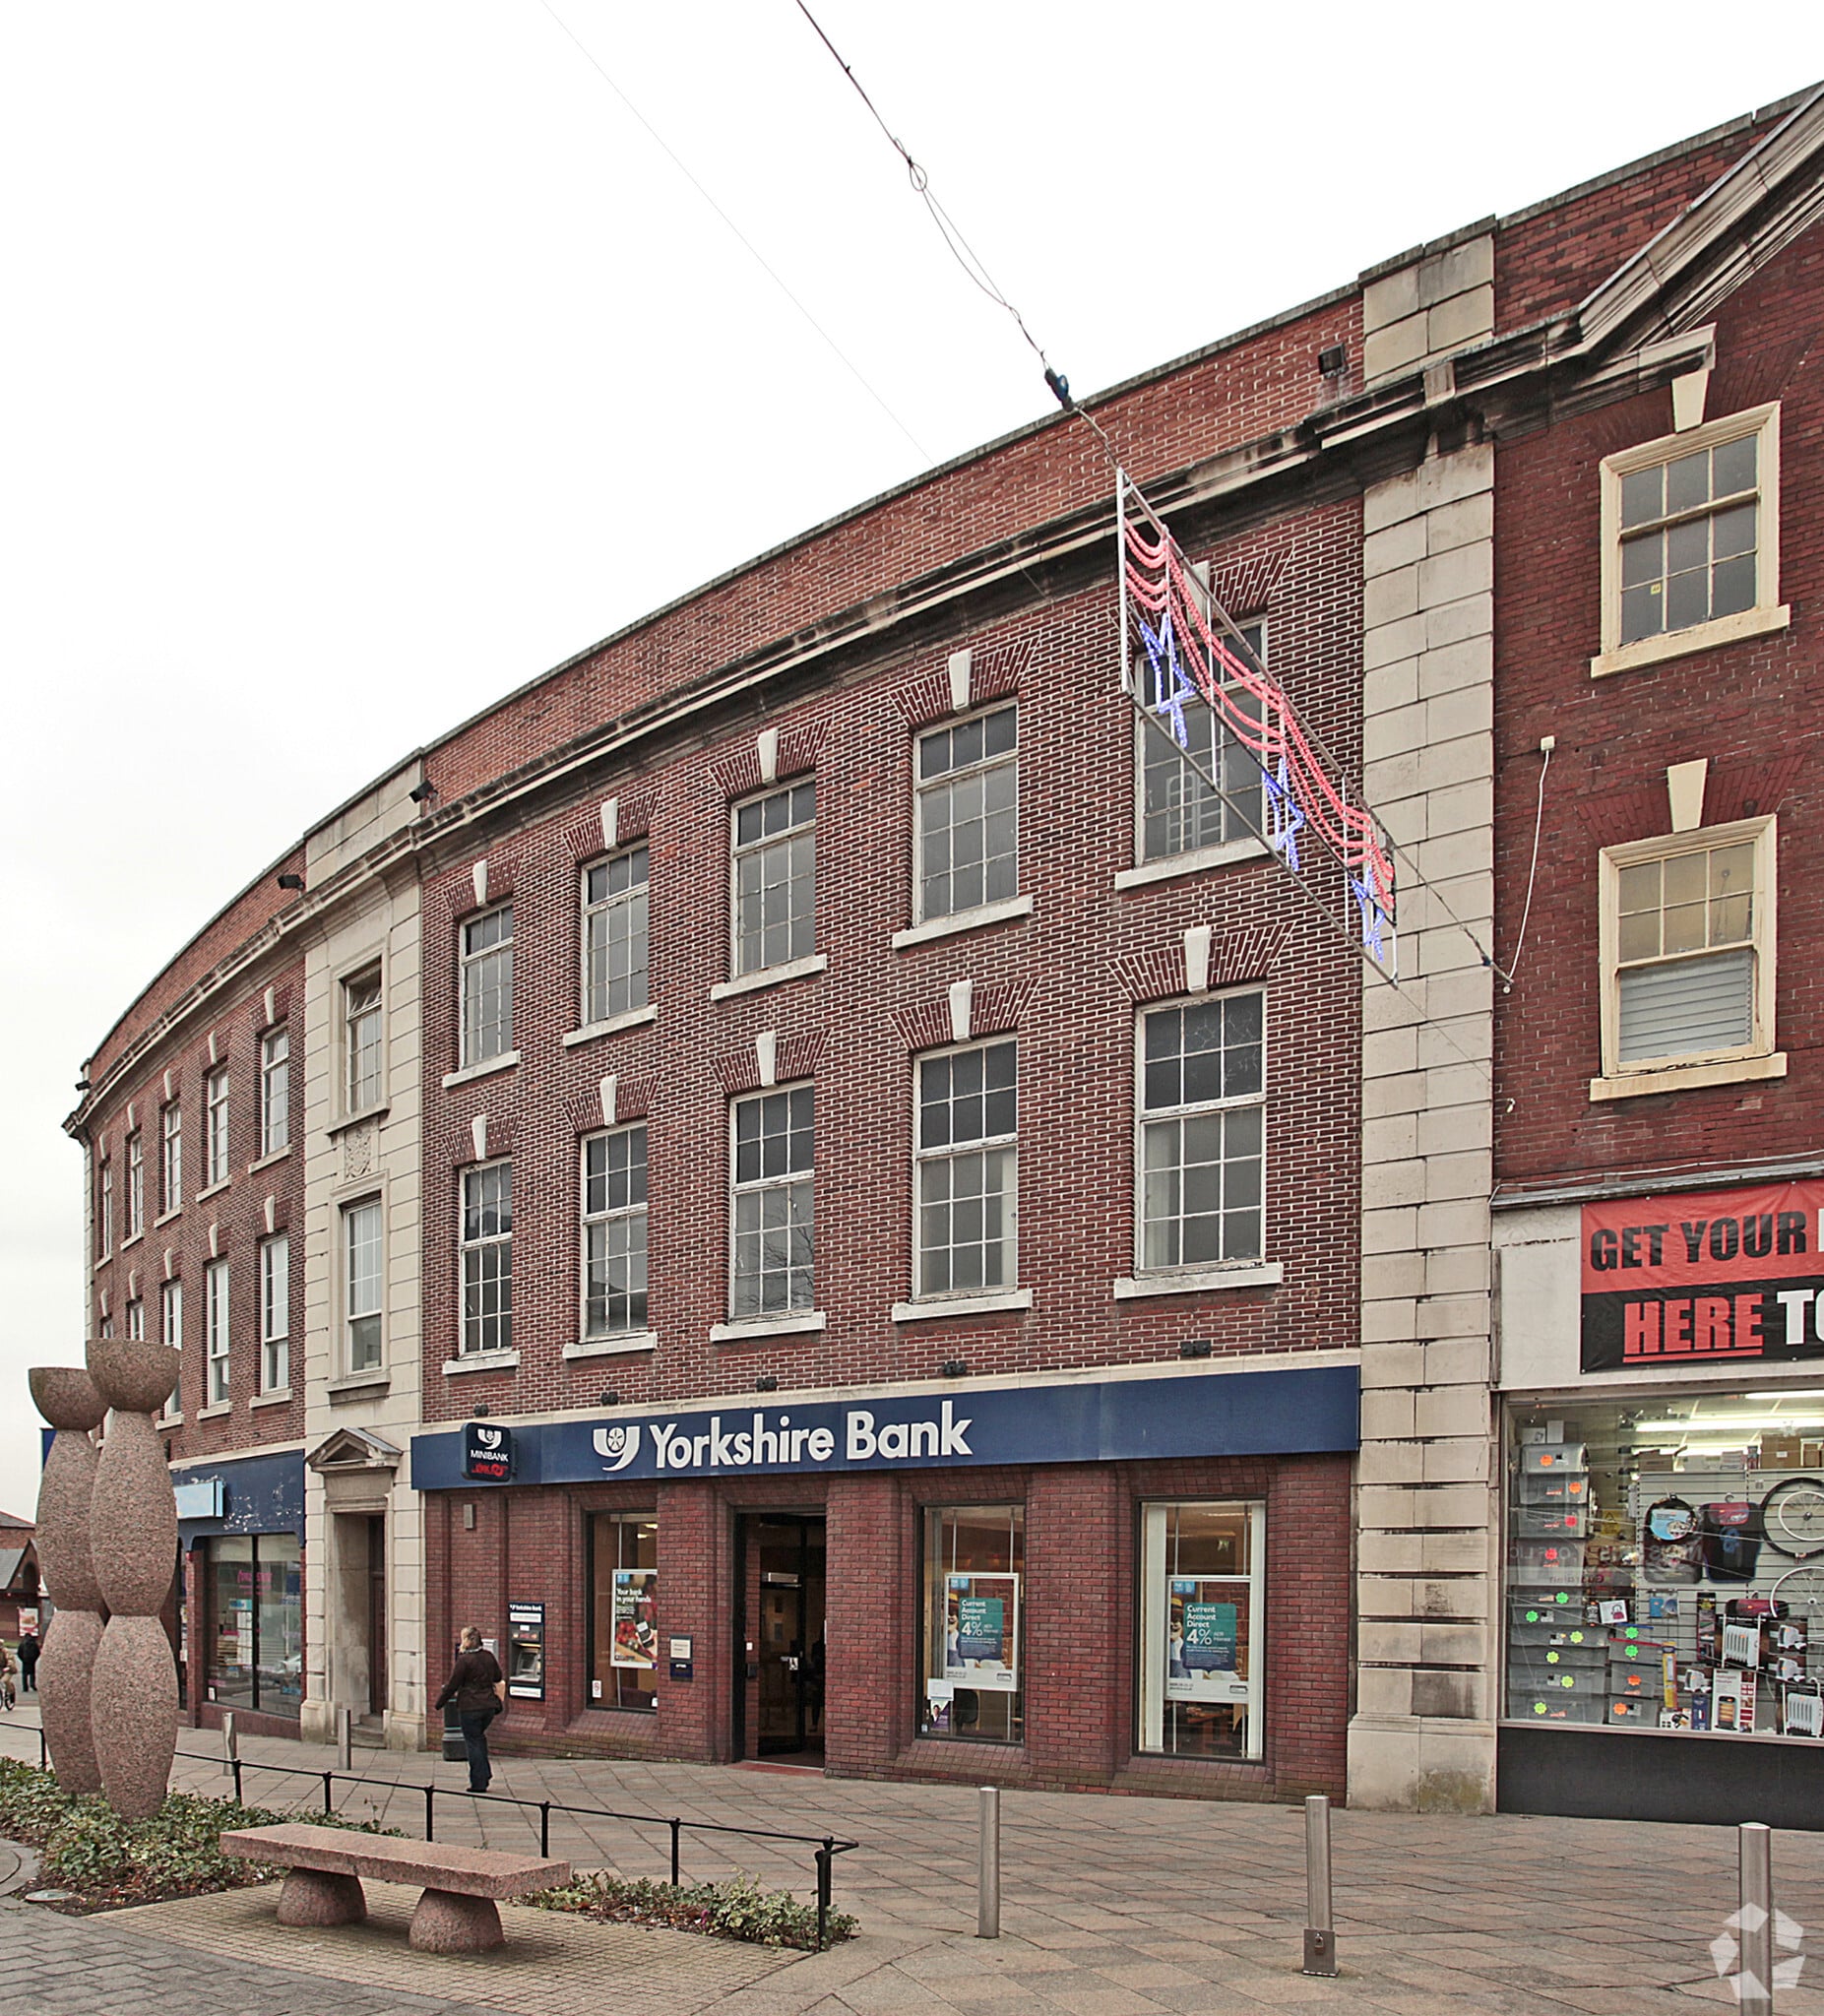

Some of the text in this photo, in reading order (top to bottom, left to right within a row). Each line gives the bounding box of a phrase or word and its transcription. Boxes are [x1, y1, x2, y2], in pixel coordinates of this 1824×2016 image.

[1590, 1223, 1669, 1272] GET
[1679, 1211, 1807, 1263] YOUR
[1623, 1289, 1824, 1355] HERE T
[649, 1399, 975, 1470] Yorkshire Bank
[470, 1449, 509, 1463] MINIBANK
[1186, 1605, 1217, 1613] Current
[961, 1621, 983, 1637] 4%
[1186, 1628, 1213, 1645] 4%
